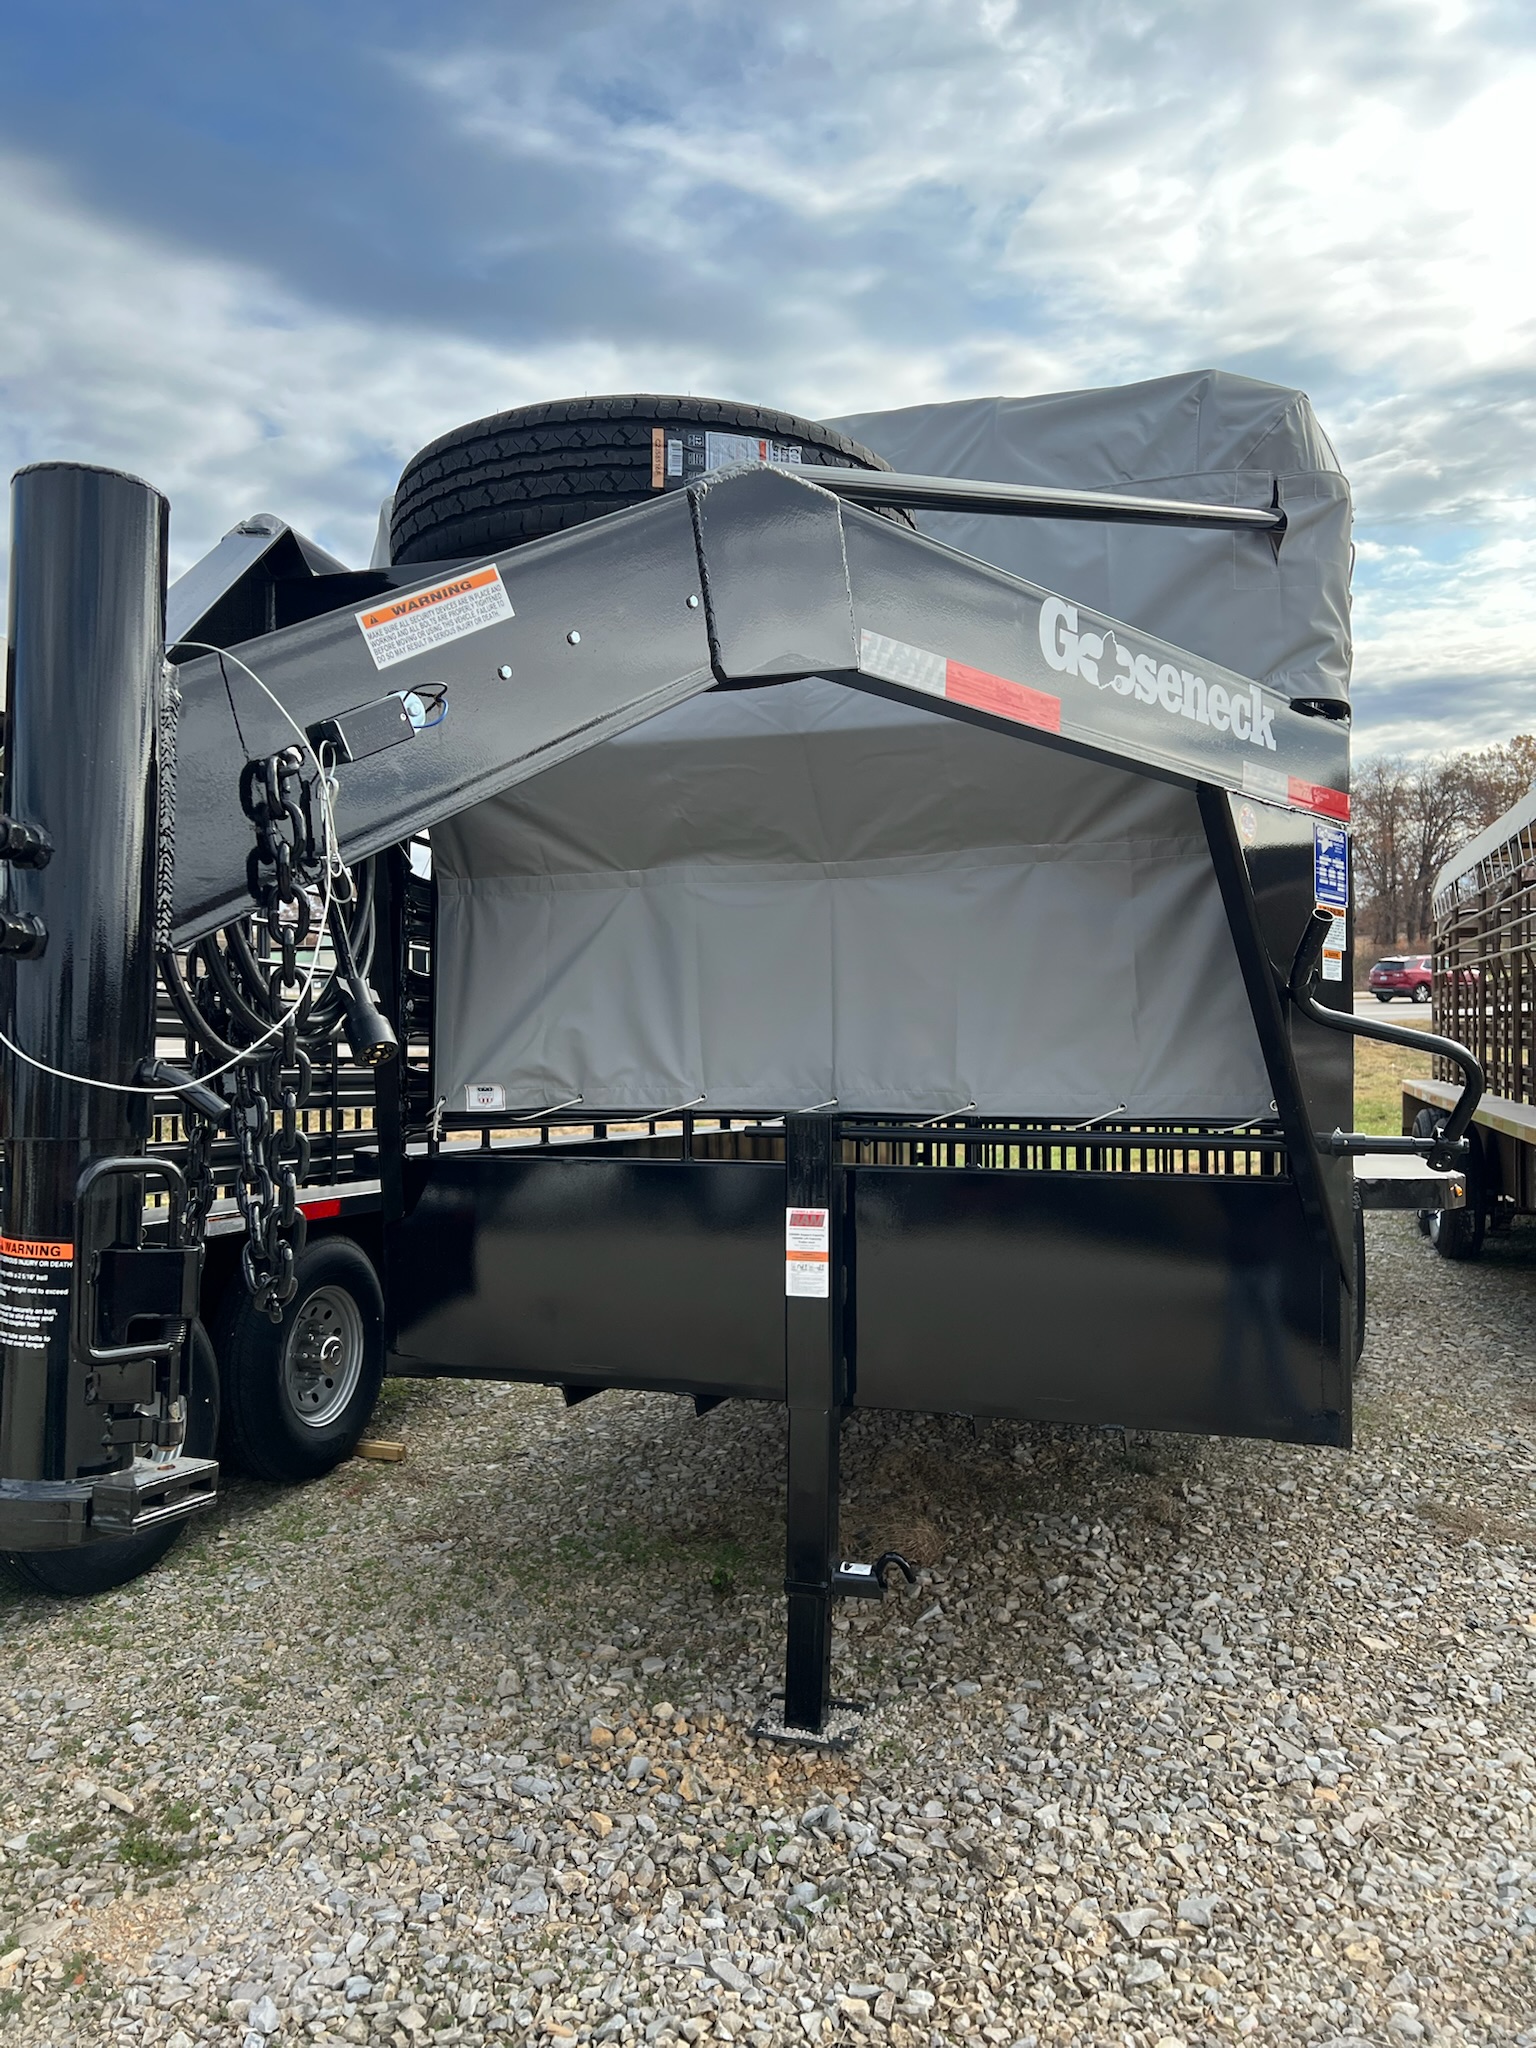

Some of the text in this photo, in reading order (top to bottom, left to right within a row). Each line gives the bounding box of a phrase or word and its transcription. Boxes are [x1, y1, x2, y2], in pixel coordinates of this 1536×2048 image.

[367, 629, 383, 639] MAKE
[383, 623, 398, 633] SURE
[398, 619, 409, 627] ALL
[409, 610, 434, 623] SECURITY
[435, 601, 456, 613] DEVICES
[457, 597, 468, 605] ARE
[474, 588, 490, 598] PLACE
[490, 584, 501, 592] AND
[370, 633, 396, 647] WORKING
[396, 629, 408, 637] AND
[420, 618, 437, 628] BOLTS
[448, 604, 474, 617] PROPERLY
[475, 593, 501, 607] TIGHTENED
[391, 580, 471, 615] WARNING
[374, 642, 395, 654] BEFORE
[396, 634, 417, 646] MOVING
[417, 630, 425, 638] OR
[425, 624, 442, 634] USING
[442, 619, 453, 628] THIS
[476, 603, 496, 614] FAILURE
[386, 651, 394, 659] SO
[394, 647, 406, 655] MAY
[406, 638, 427, 650] RESULT
[433, 627, 456, 640] SERIOUS
[456, 620, 473, 631] INJURY
[1039, 596, 1277, 751] Gooseneck
[4, 1241, 61, 1257] WARNING
